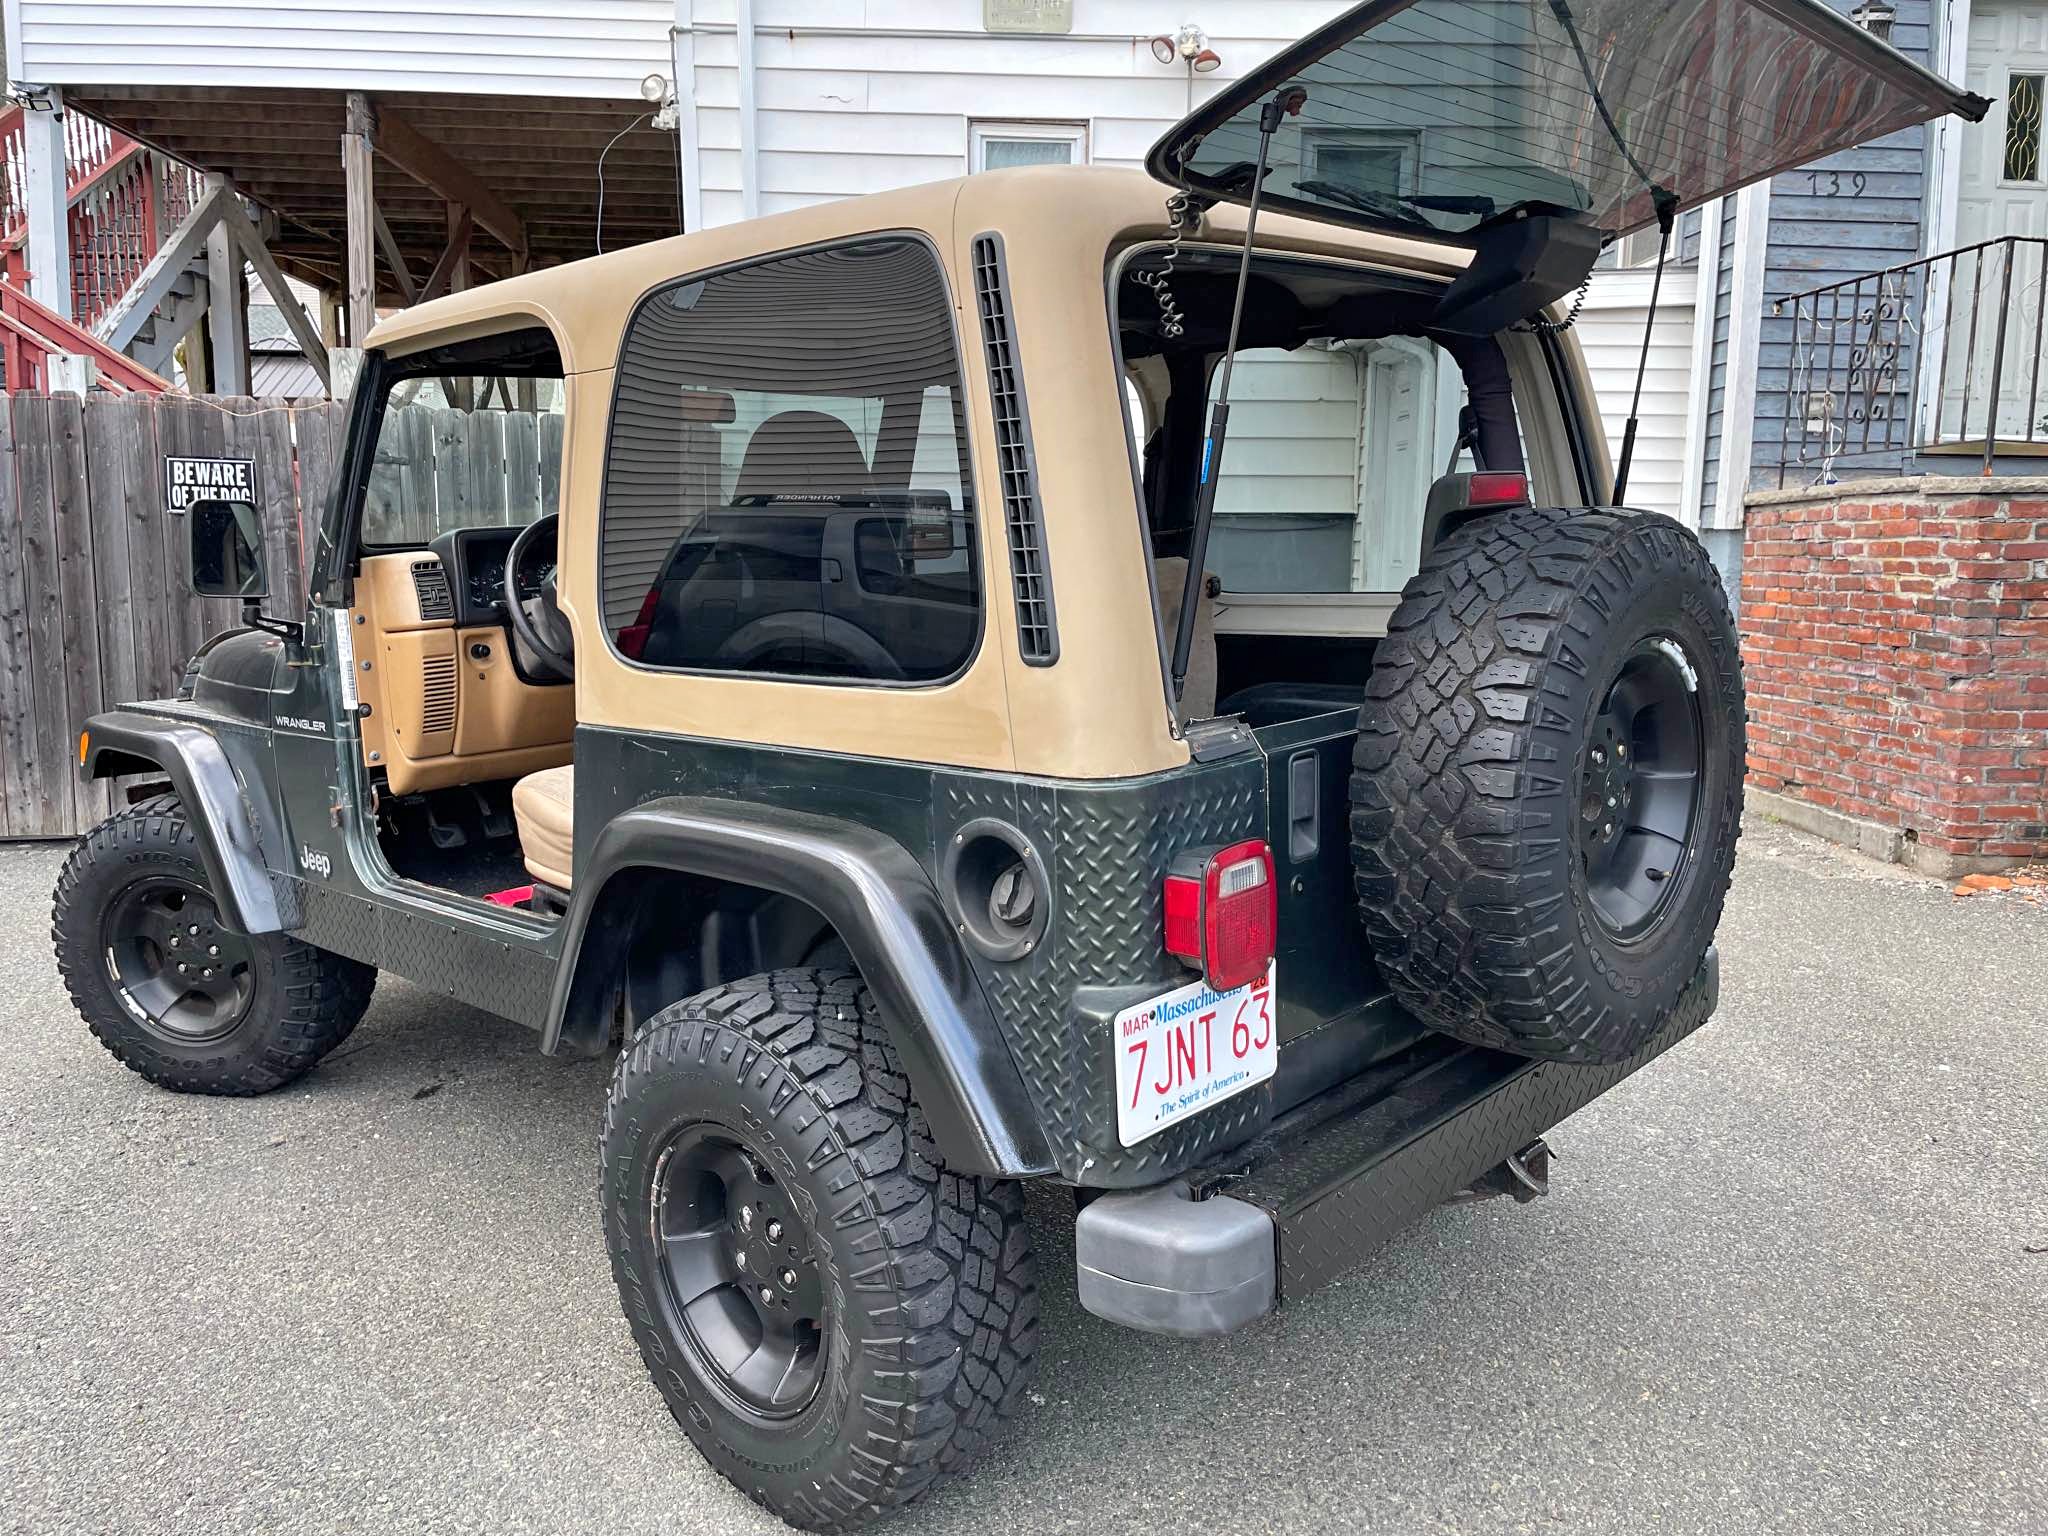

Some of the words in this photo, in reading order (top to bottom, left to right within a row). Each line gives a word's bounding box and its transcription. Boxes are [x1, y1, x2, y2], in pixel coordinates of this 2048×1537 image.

[1806, 171, 1866, 199] 139
[173, 461, 247, 486] BEWARE
[172, 485, 189, 507] OF
[191, 486, 217, 500] THE
[275, 714, 327, 732] WRANGLER
[300, 845, 331, 878] Jeep
[1123, 1013, 1149, 1038] MAR
[1128, 1040, 1148, 1110] 7
[1154, 1011, 1217, 1095] JNT
[1232, 990, 1270, 1059] 63
[1160, 1102, 1176, 1117] The
[1178, 1089, 1200, 1109] Spirit
[1202, 1083, 1210, 1098] of
[1211, 1071, 1244, 1093] America
